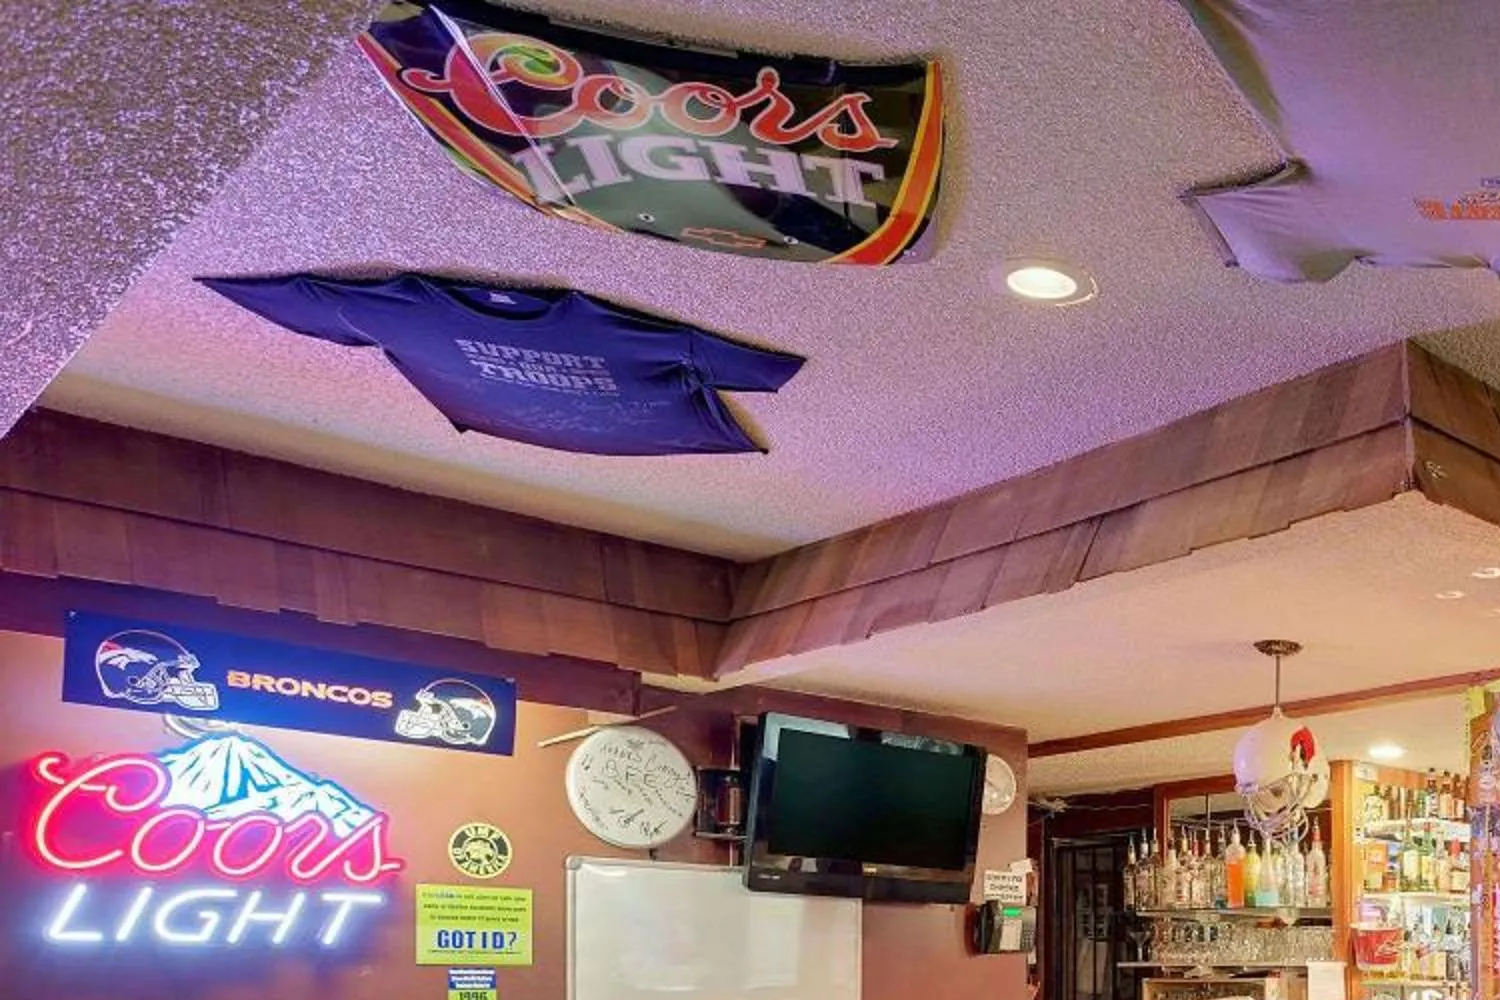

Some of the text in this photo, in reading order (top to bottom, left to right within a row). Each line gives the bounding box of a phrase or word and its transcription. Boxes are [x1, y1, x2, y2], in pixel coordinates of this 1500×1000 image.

[401, 32, 898, 152] Coors
[511, 134, 885, 209] LIGHT
[469, 360, 617, 391] TROOPS
[226, 669, 393, 709] BRONCOS
[35, 755, 403, 882] Coors
[49, 882, 383, 945] LIGHT
[437, 929, 517, 950] GOT ID?
